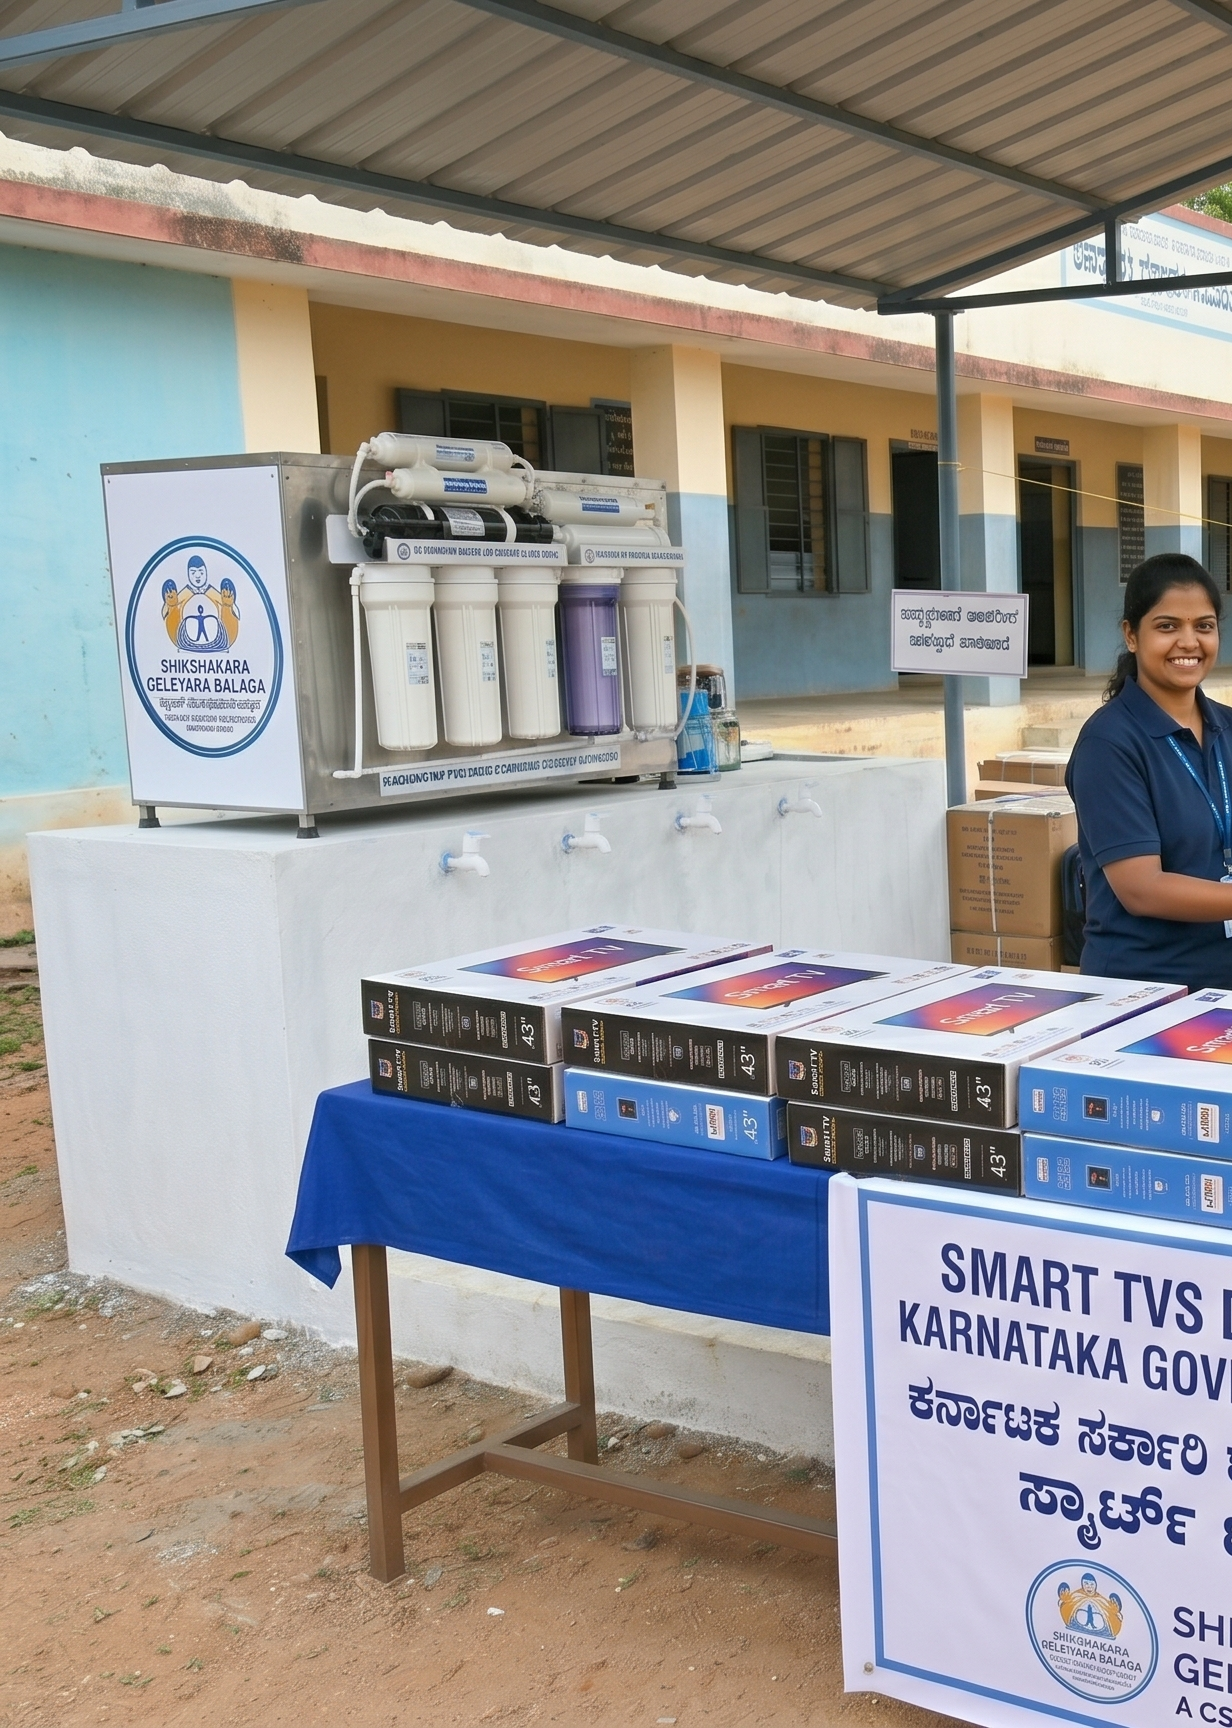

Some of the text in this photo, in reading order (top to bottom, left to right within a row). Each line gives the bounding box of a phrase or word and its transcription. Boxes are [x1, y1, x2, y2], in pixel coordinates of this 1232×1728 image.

[161, 658, 250, 675] SHIKSHAKARA
[147, 677, 266, 694] GELEYARA BALAGA
[580, 942, 625, 963] TV
[788, 966, 826, 985] TV
[995, 991, 1037, 1010] TV
[989, 1146, 1007, 1178] 43"
[941, 1242, 1099, 1317] SMART
[1114, 1270, 1204, 1335] TVS
[899, 1300, 1129, 1384] KARNATAKA
[908, 1376, 1061, 1447] ಕರ್ನಾಟಕ
[1077, 1408, 1208, 1476] ಸರ್ಕಾರಿ
[1099, 1653, 1143, 1673] BALAGA
[1175, 1696, 1193, 1719] A
